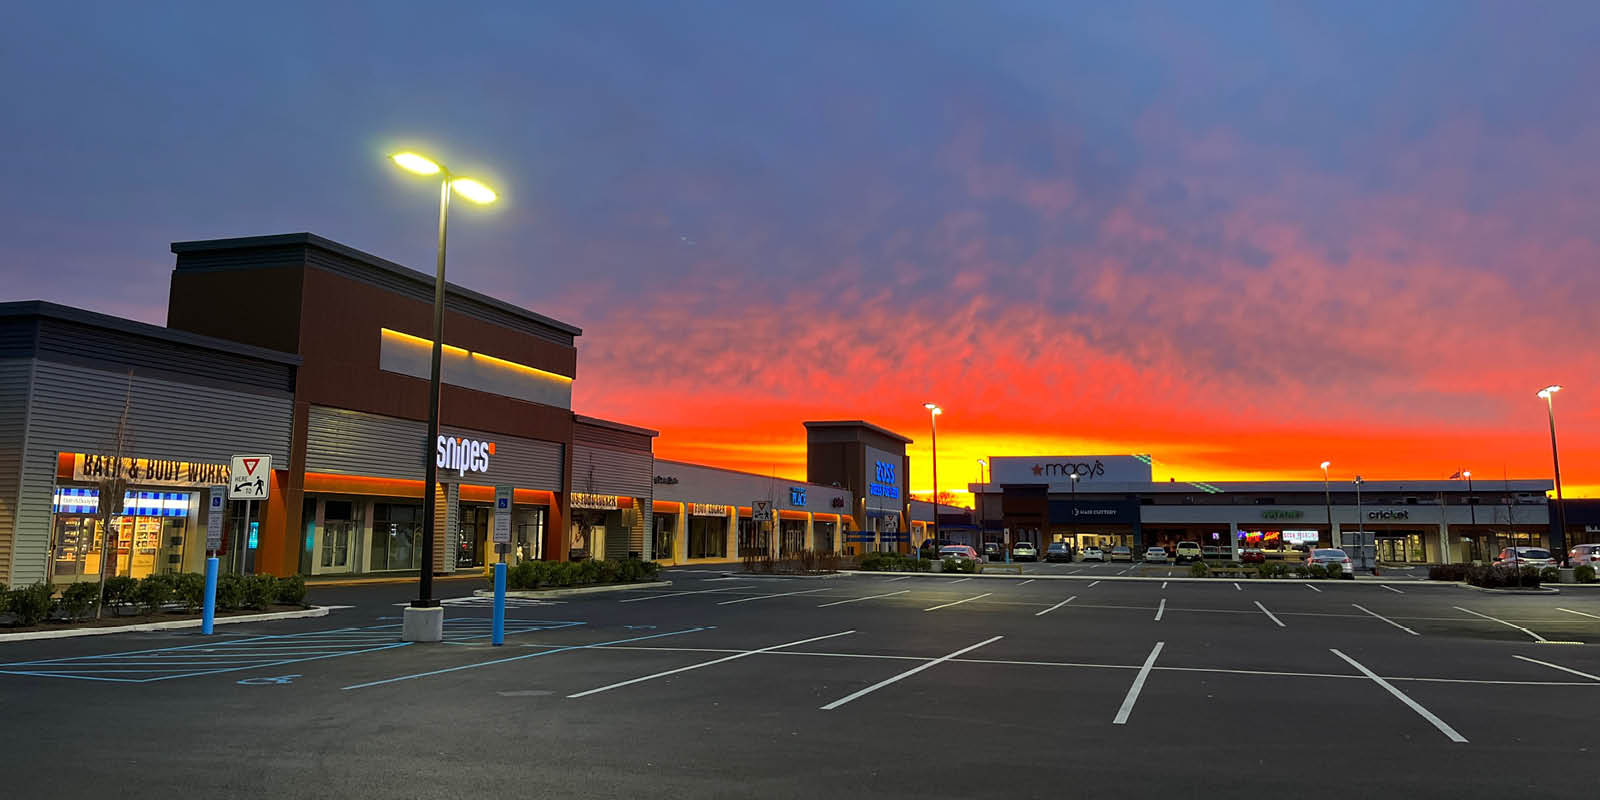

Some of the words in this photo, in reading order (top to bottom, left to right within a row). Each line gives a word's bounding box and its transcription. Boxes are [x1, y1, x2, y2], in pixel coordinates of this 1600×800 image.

[437, 435, 489, 477] snipes
[128, 458, 139, 479] &
[146, 460, 181, 481] BODY
[188, 462, 231, 484] WORKS
[1046, 459, 1105, 480] macy's
[1368, 510, 1409, 520] cricket
